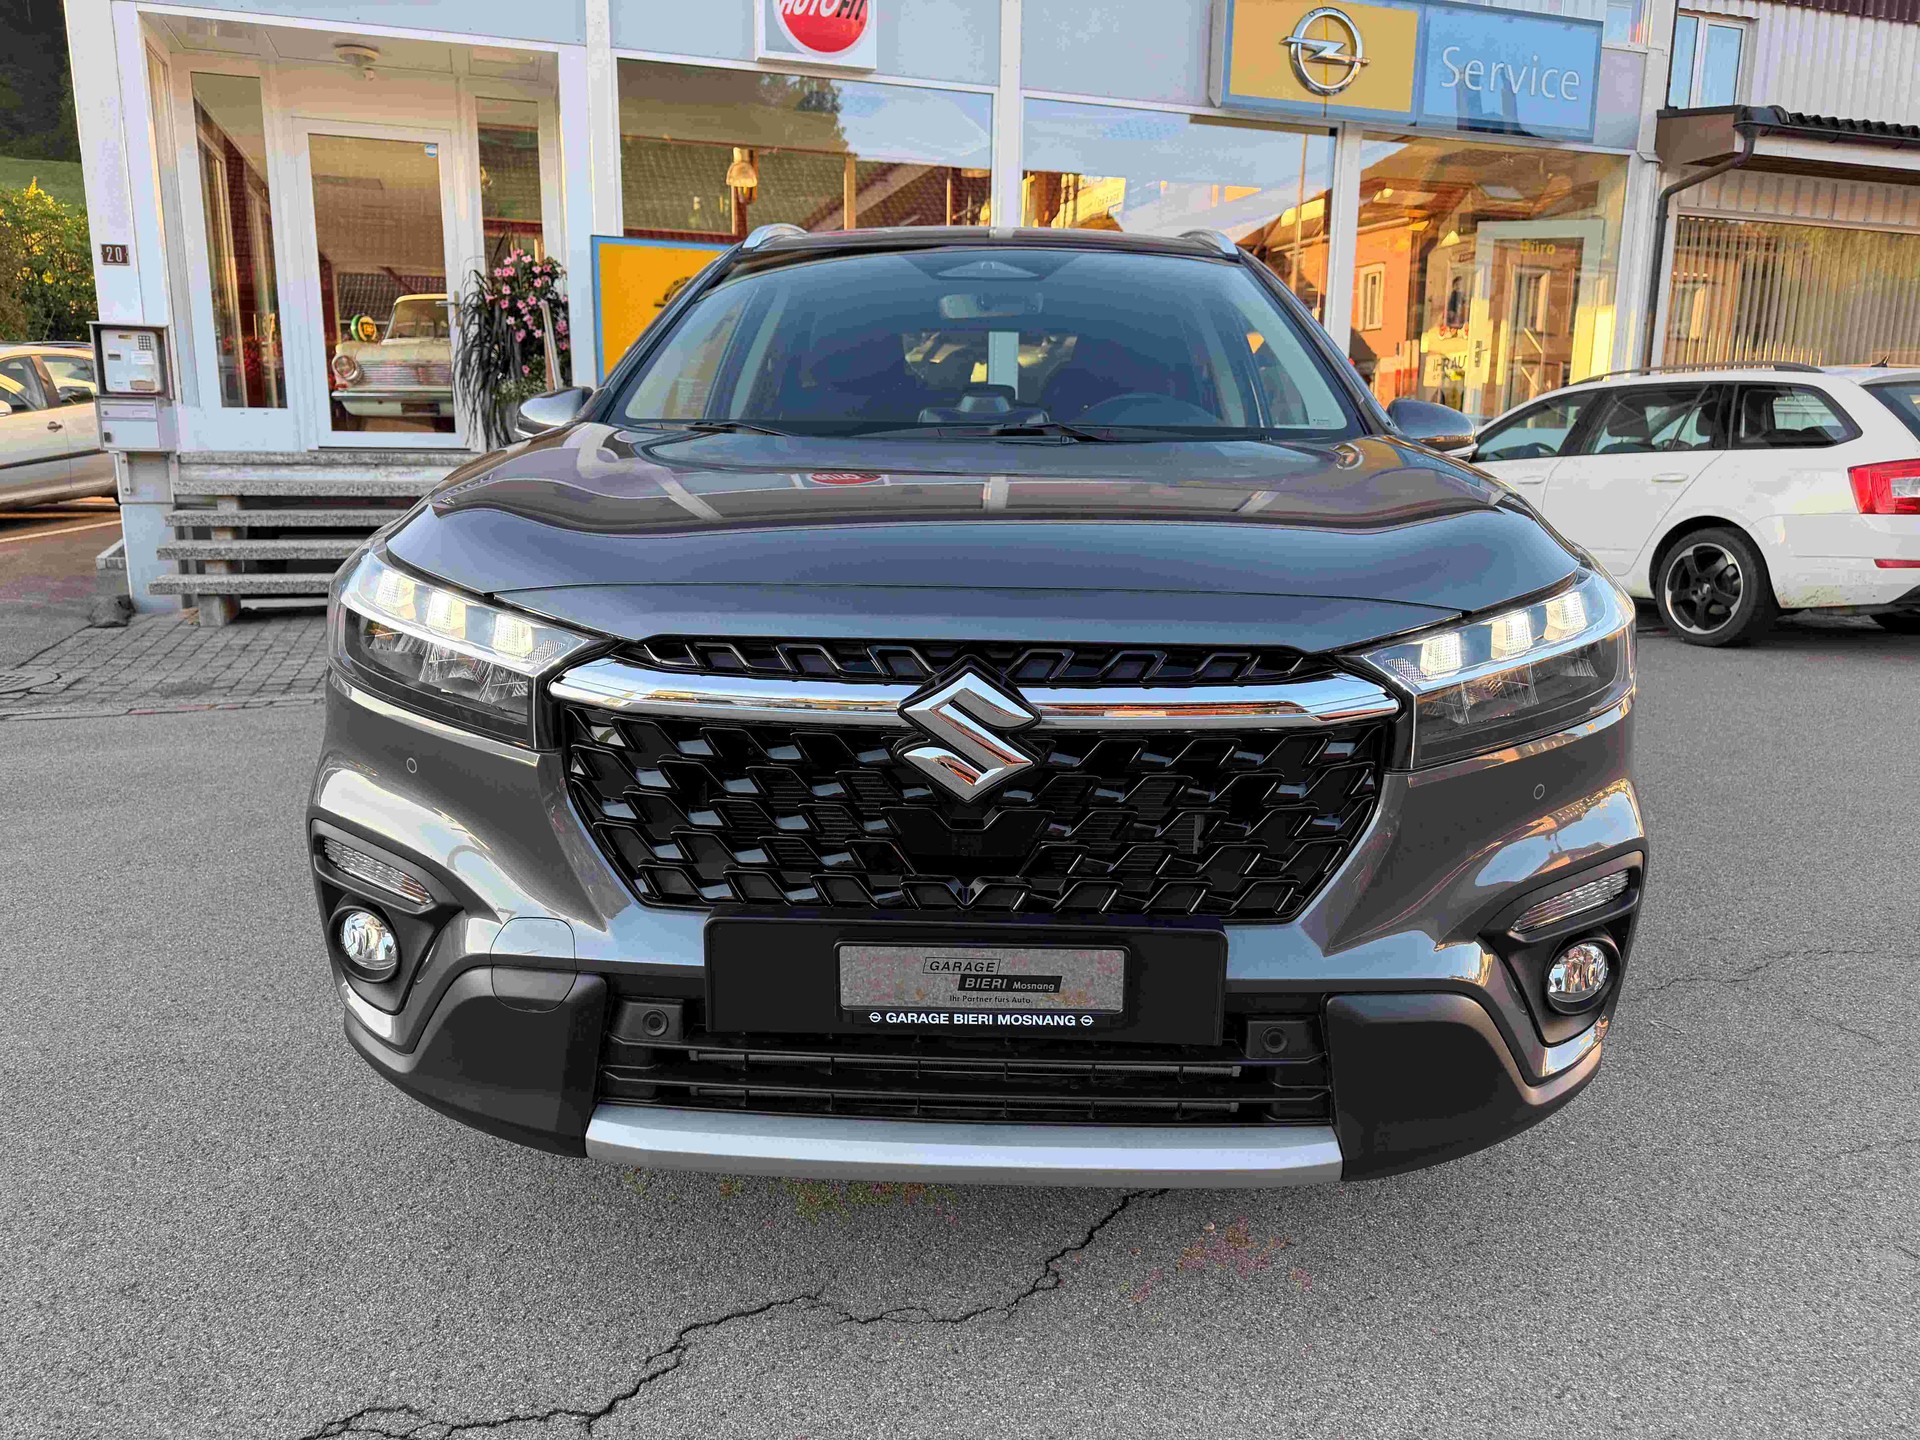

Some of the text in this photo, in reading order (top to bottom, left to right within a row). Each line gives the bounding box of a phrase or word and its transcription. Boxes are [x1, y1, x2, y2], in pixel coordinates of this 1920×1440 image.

[1440, 46, 1581, 101] Service
[106, 246, 123, 263] 20
[1519, 240, 1556, 256] Büro
[929, 960, 996, 973] GARAGE
[965, 977, 1055, 992] BIERI Mosnang
[962, 995, 993, 1003] Partner
[885, 1012, 1076, 1026] GARAGE BIERI MOSNANG
